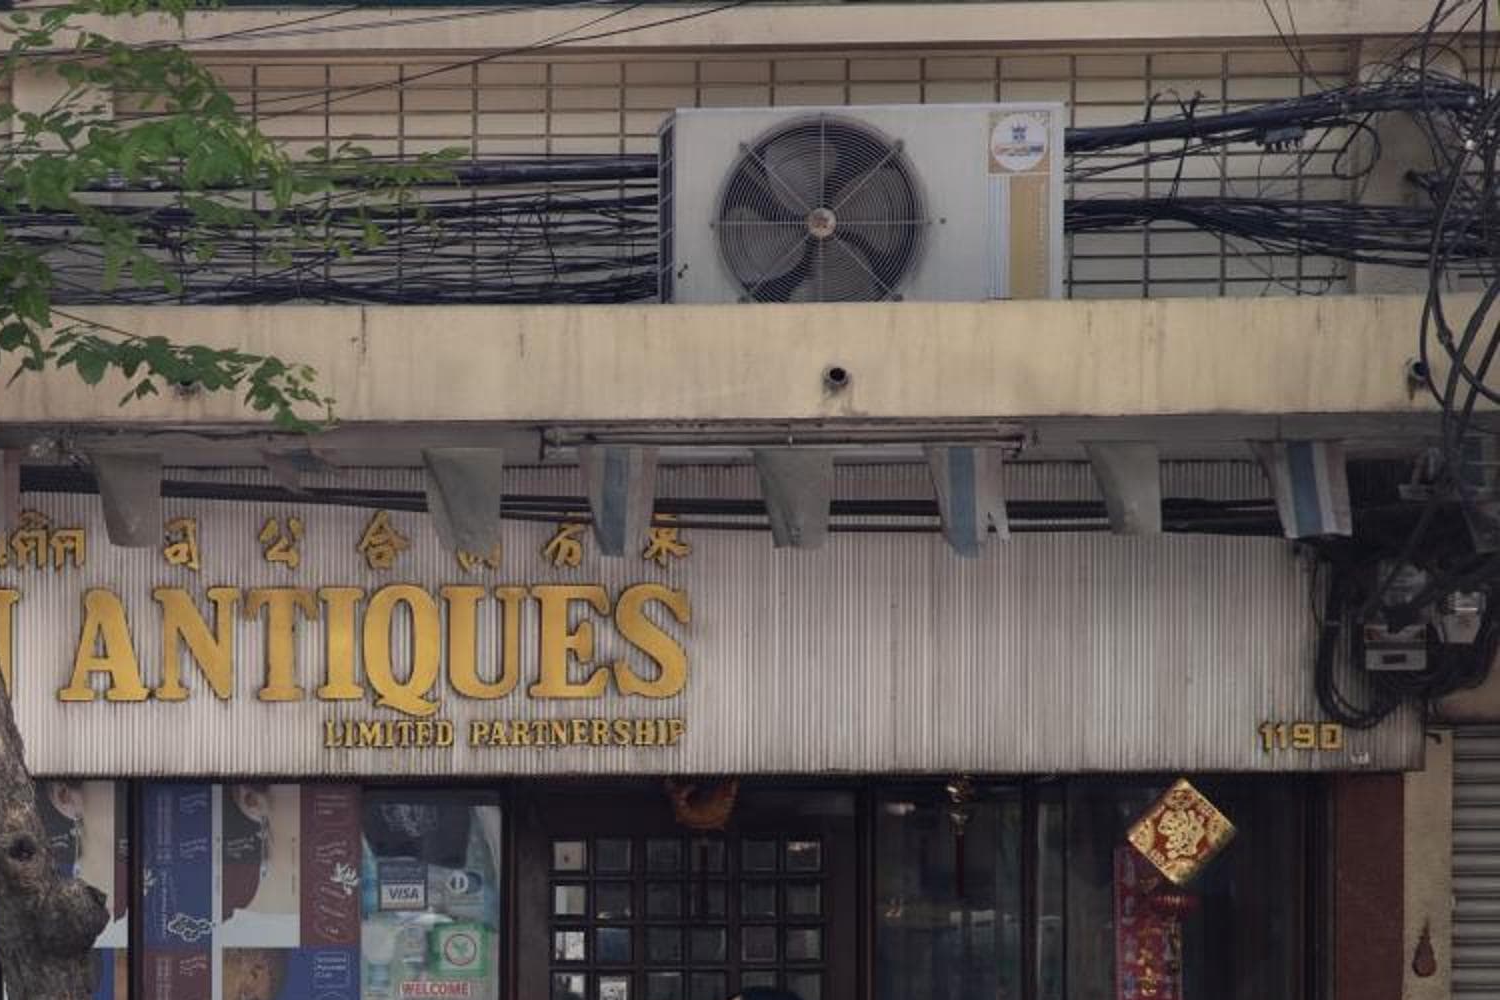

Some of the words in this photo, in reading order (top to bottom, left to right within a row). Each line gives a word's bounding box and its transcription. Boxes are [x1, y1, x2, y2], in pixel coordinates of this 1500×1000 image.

[57, 583, 692, 717] ANTIQUES
[323, 719, 454, 748] LIMITED
[469, 718, 686, 748] PARTNERSHIP
[1258, 720, 1344, 752] 1190
[388, 887, 420, 901] VISA
[402, 980, 469, 995] WELCOME
